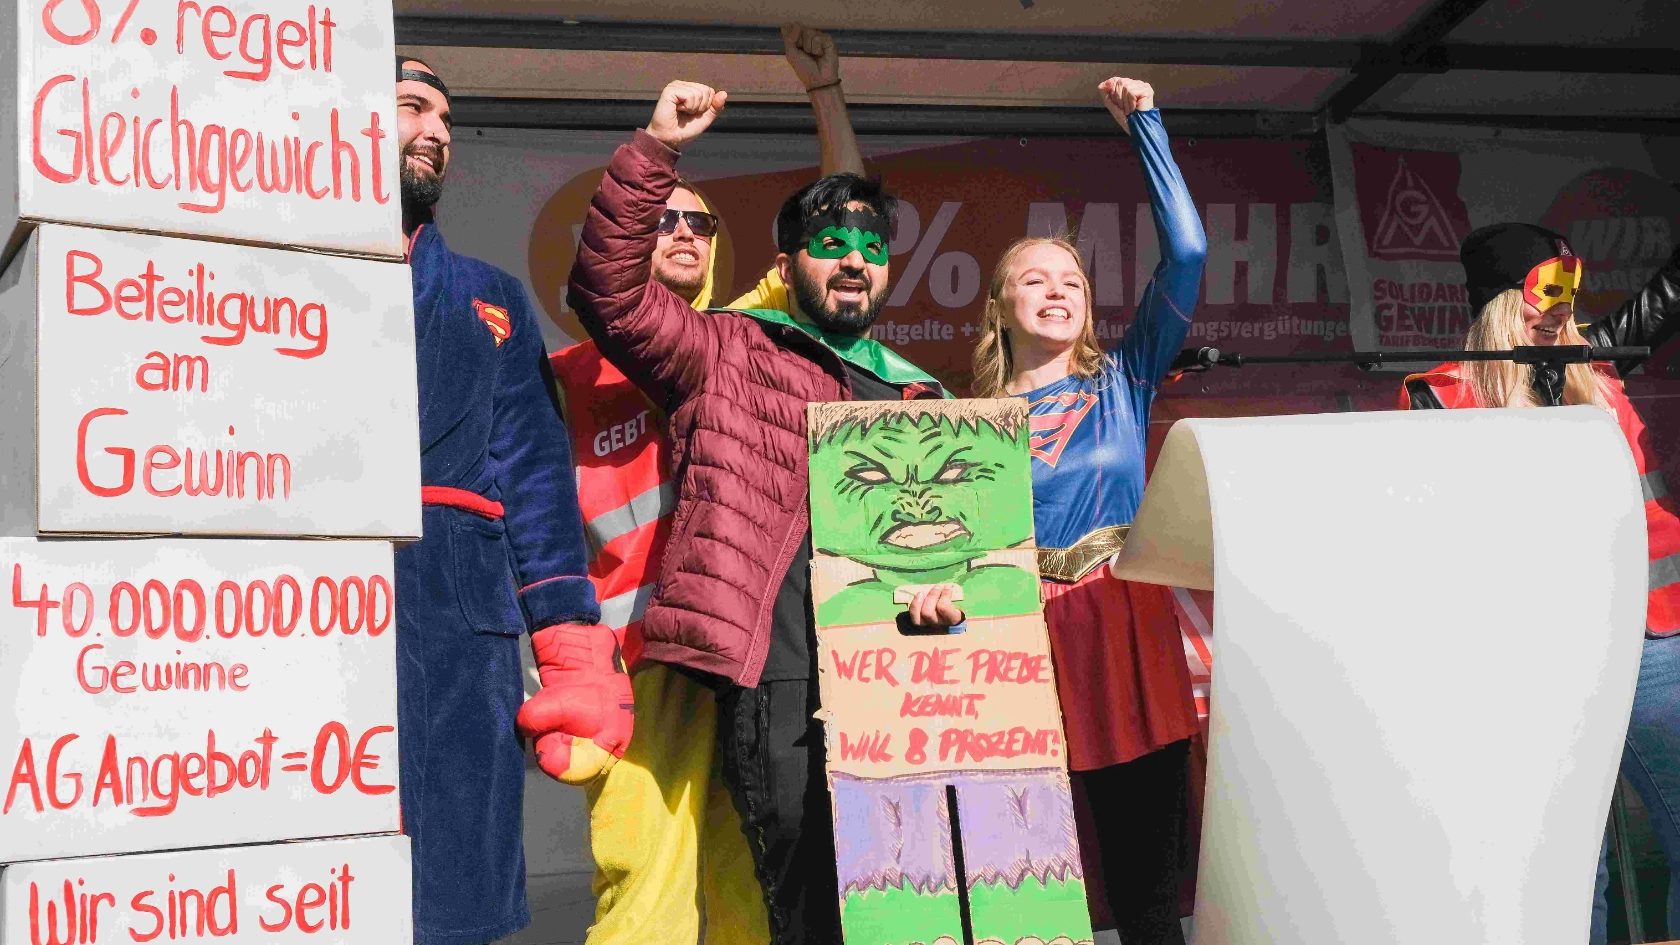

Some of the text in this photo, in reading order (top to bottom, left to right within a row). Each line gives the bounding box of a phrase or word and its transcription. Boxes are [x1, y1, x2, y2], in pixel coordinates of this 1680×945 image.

[178, 0, 336, 81] regelt
[32, 74, 390, 213] Gleichgewicht
[66, 250, 327, 359] Beteiligung
[1373, 277, 1468, 304] SOLIDARI
[871, 319, 954, 345] ntgelte
[1375, 303, 1473, 335] GEWIN
[135, 350, 208, 392] am
[76, 408, 291, 501] Gewinn
[593, 409, 650, 457] GEBT
[12, 563, 392, 641] 40.000.000.000
[76, 644, 251, 693] Gewinne
[831, 647, 899, 688] WER
[908, 646, 962, 688] DIE
[839, 730, 895, 763] WILL
[904, 727, 929, 765] 8
[3, 733, 84, 814] AG
[29, 863, 355, 945] Wir sind seit
